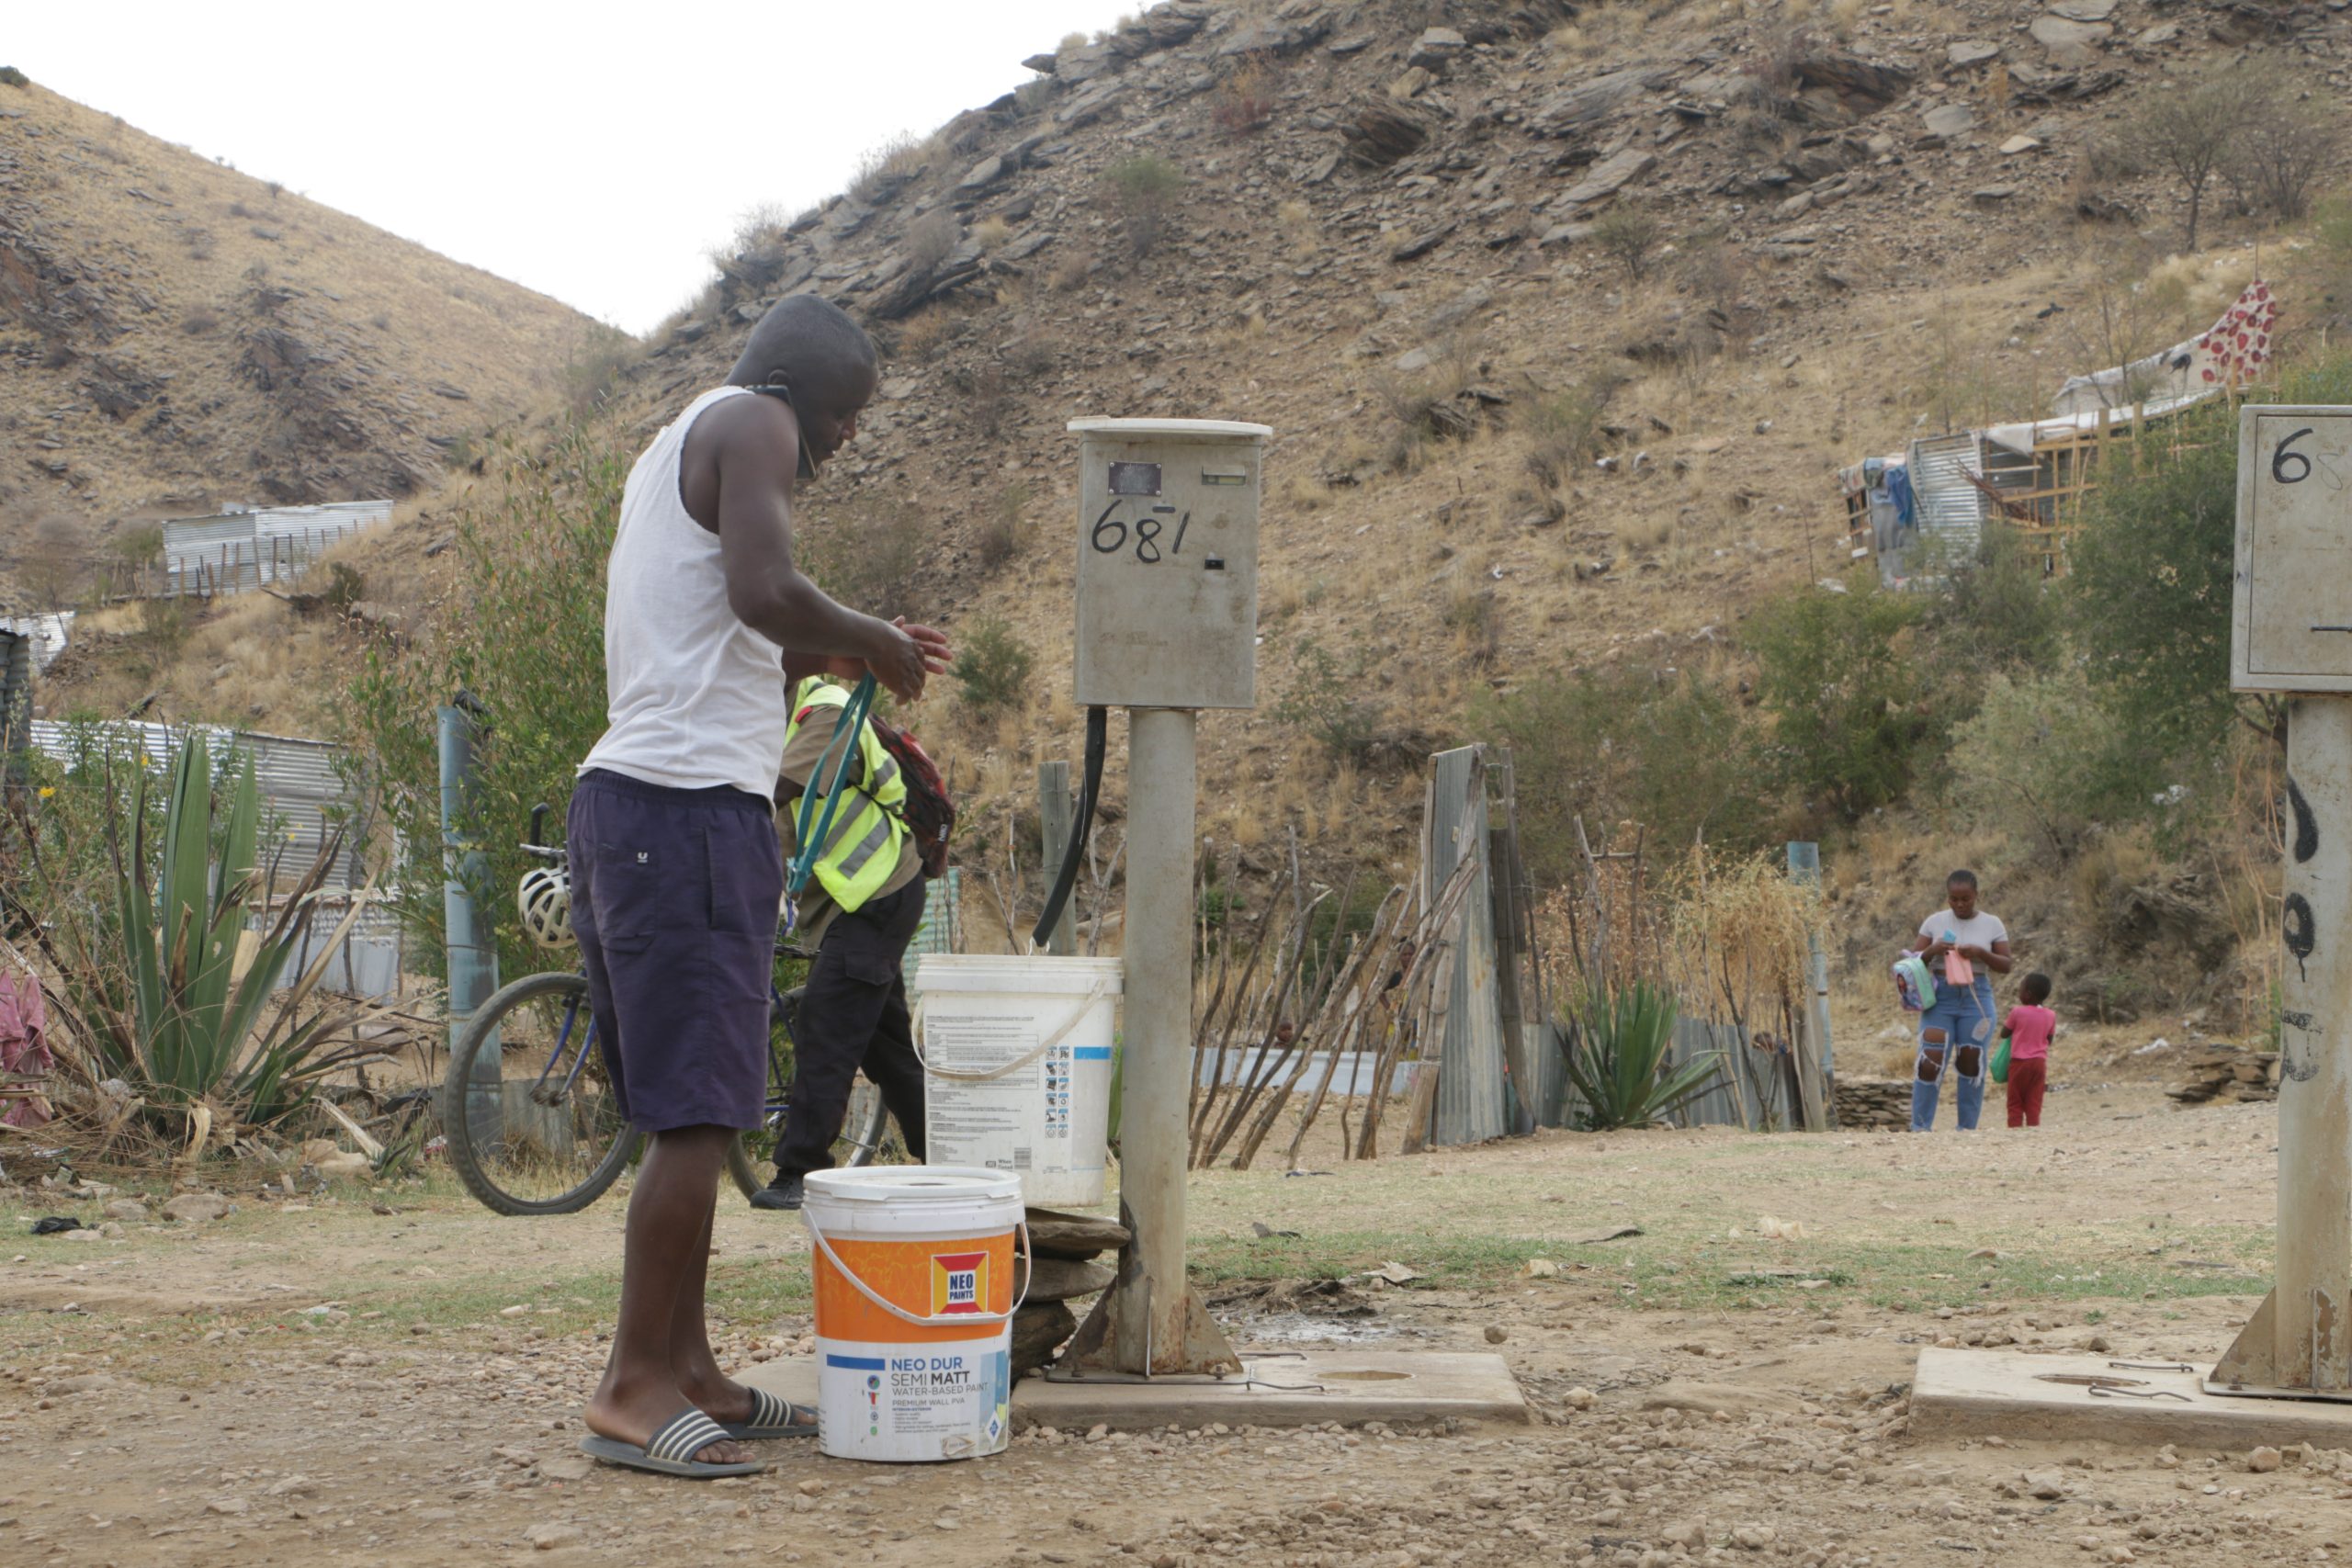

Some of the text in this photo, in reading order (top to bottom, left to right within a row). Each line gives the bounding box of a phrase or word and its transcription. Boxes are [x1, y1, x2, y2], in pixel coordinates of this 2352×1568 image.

[1091, 499, 1190, 564] 681
[949, 1273, 974, 1290] NEO
[949, 1290, 974, 1300] PAINTS
[891, 1357, 963, 1371] NEO DUR
[890, 1371, 970, 1387] SEMI MATT
[892, 1382, 989, 1396] WATER-BASED PAINT
[951, 1397, 966, 1405] PVA
